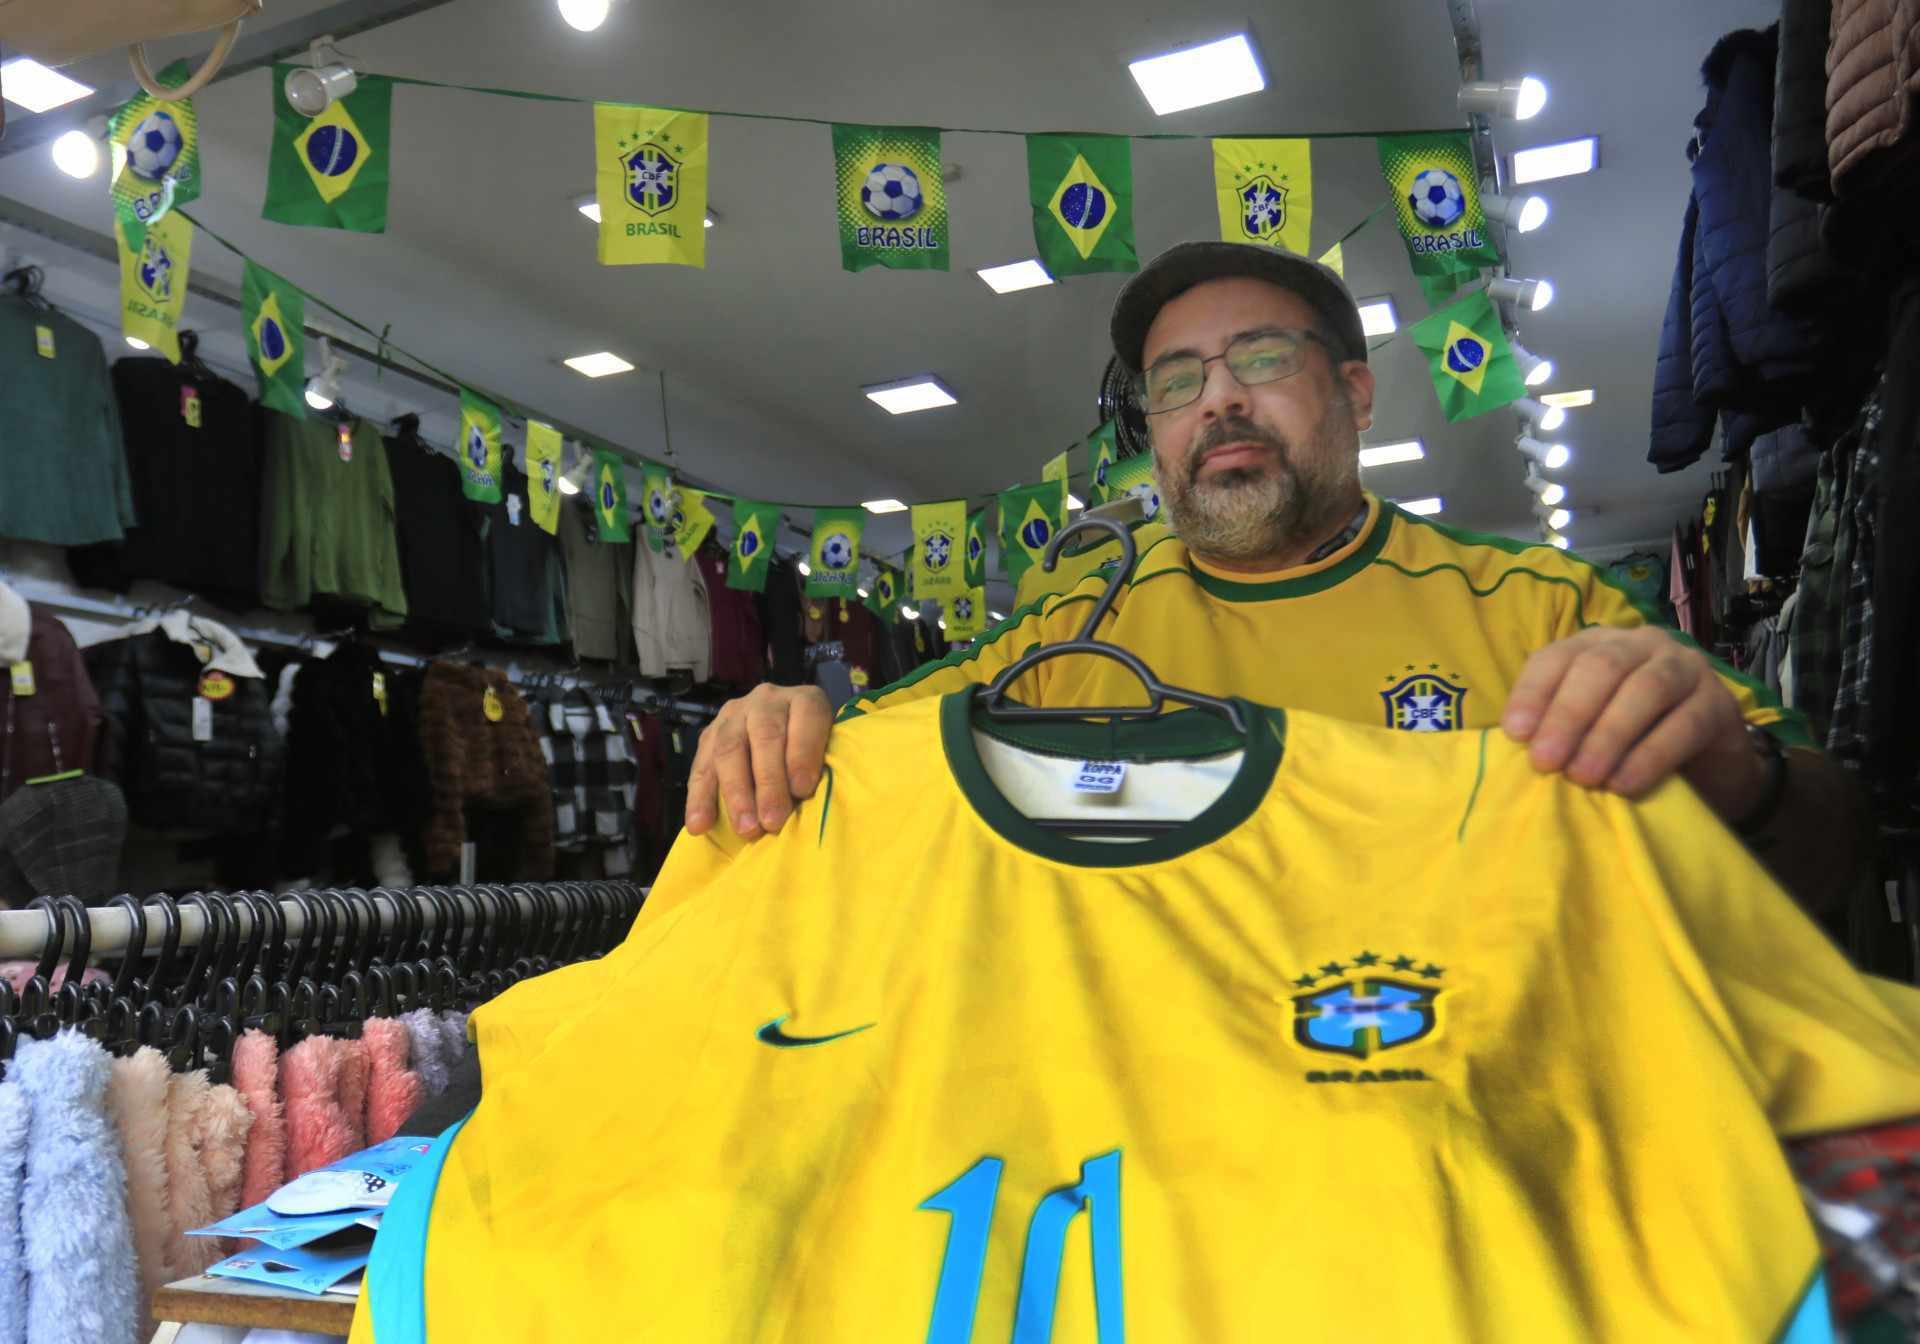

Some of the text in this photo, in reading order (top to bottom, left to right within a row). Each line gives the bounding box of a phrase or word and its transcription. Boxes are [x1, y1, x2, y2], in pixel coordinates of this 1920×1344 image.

[625, 222, 682, 239] BRASIL
[857, 226, 938, 249] BRASIL
[1411, 229, 1484, 254] BRASIL
[1411, 708, 1438, 719] CBF
